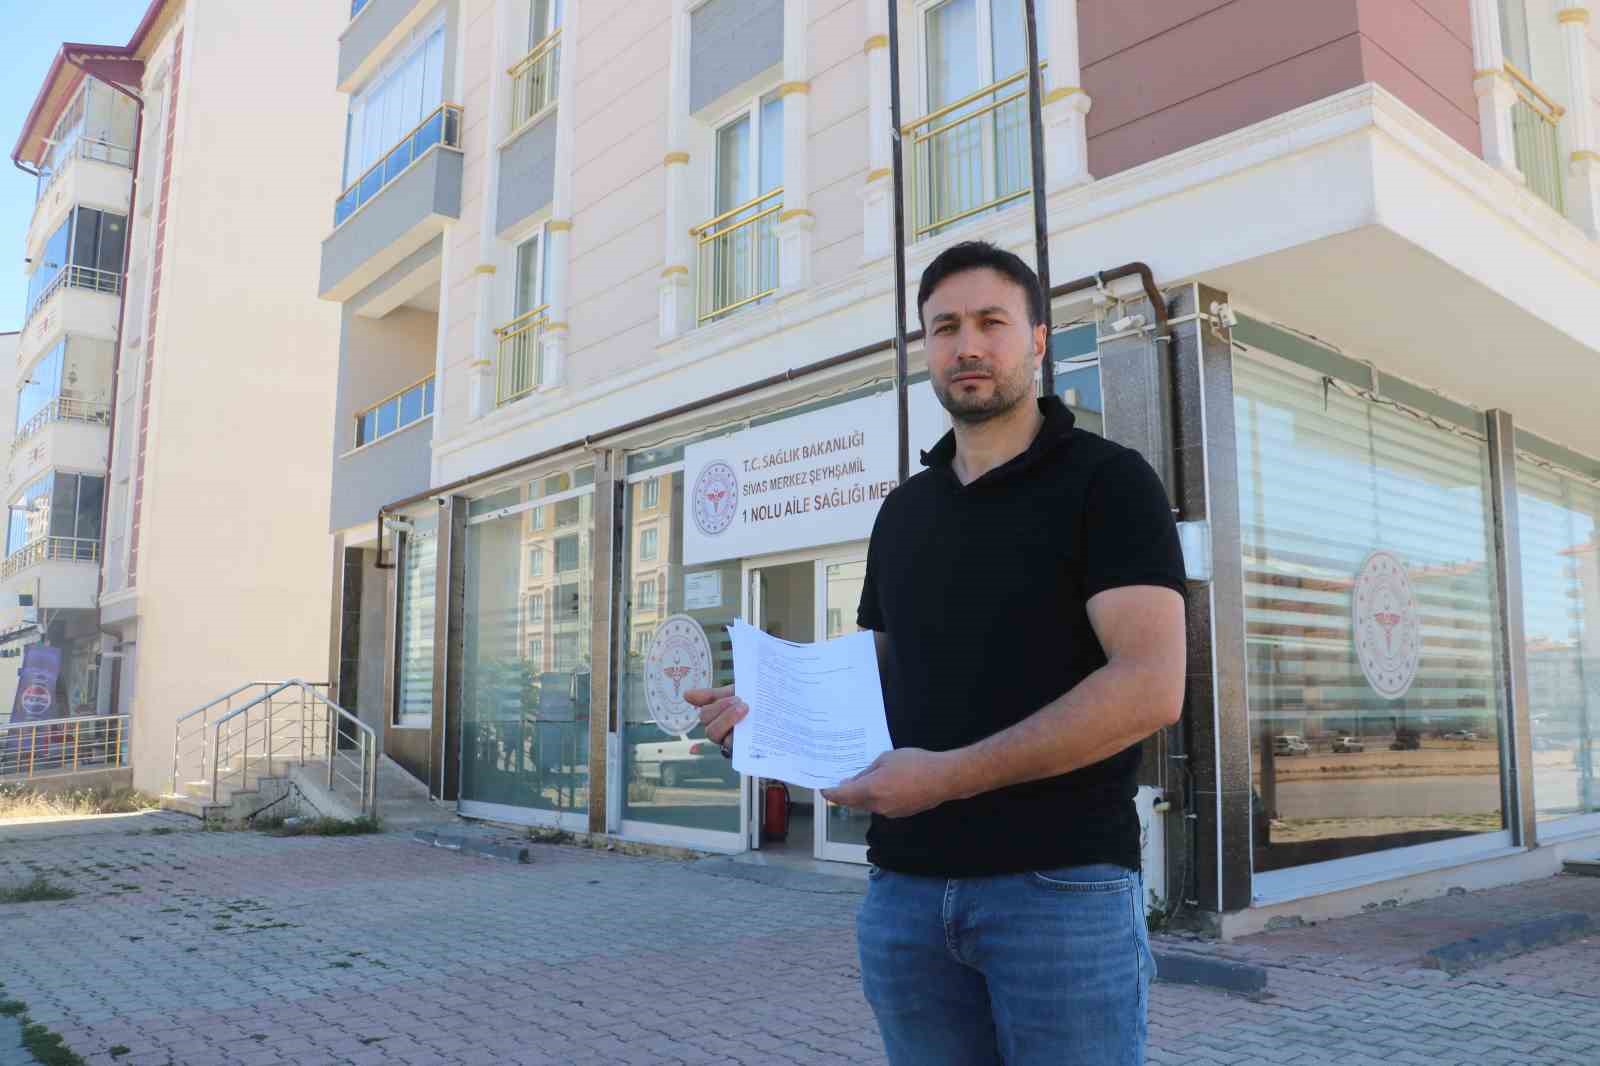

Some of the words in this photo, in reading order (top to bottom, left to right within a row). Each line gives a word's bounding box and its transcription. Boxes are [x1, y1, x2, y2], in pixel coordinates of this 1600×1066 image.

[763, 447, 801, 468] SAĞLIK
[802, 430, 864, 459] BAKANLIĞI
[742, 480, 768, 496] SİVAS
[769, 471, 808, 490] MERKEZ
[809, 457, 865, 486] ŞEYHŞAMİL
[742, 510, 747, 523] 1
[751, 502, 782, 522] NOLU
[784, 495, 811, 515] AİLE
[814, 483, 865, 511] SAĞLIĞI
